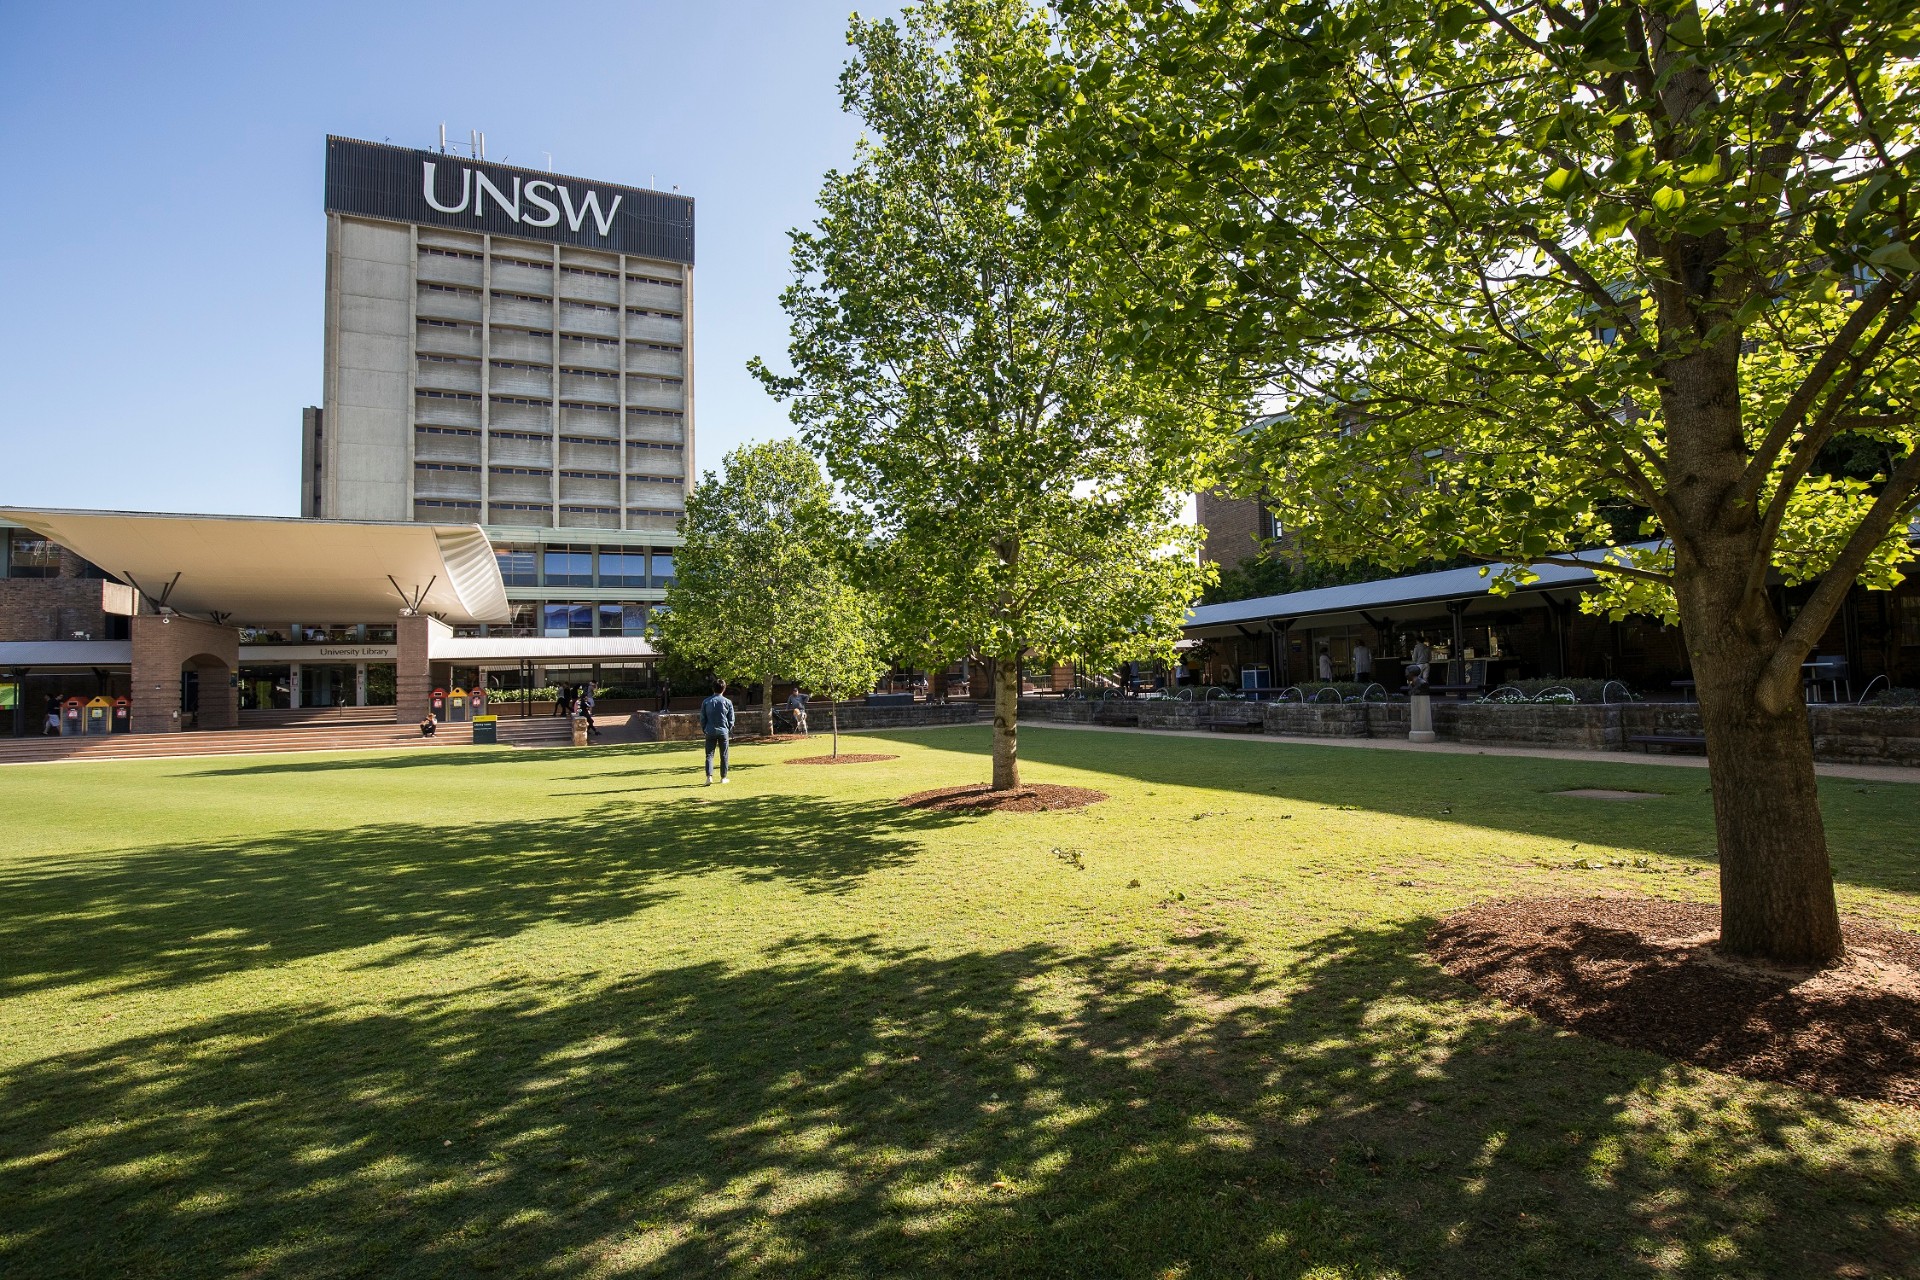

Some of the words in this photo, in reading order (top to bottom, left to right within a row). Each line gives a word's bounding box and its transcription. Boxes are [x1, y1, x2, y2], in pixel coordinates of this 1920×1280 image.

[423, 161, 622, 237] UNSW
[320, 648, 359, 656] University
[362, 648, 389, 656] Library
